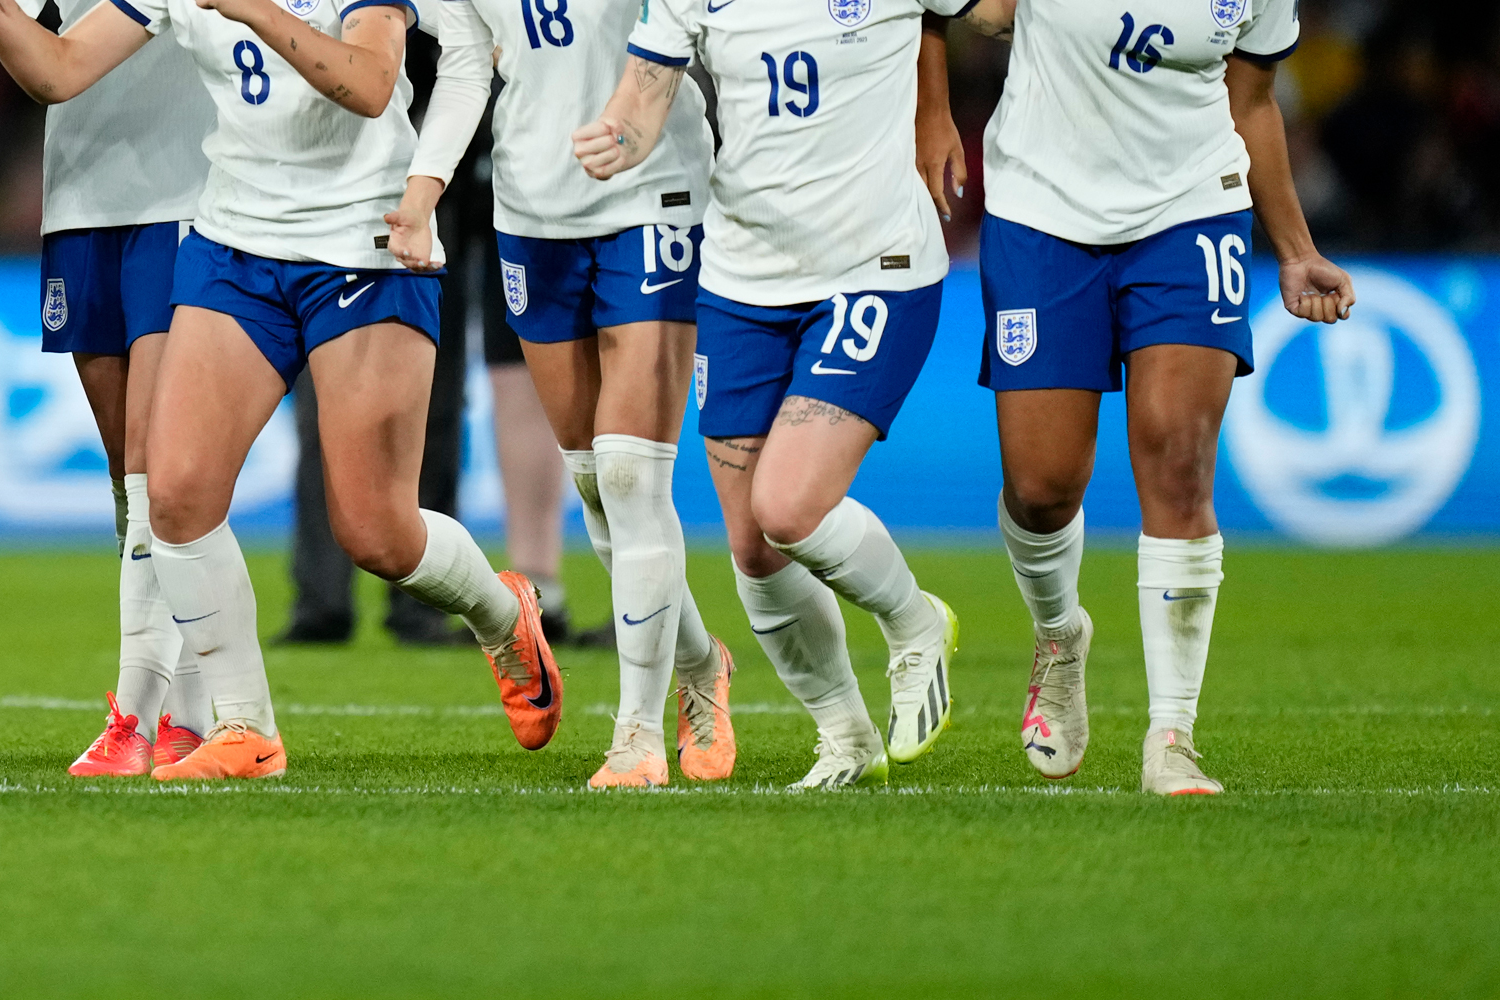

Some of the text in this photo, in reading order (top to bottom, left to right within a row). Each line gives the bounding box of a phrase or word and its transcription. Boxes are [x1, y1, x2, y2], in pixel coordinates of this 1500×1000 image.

[232, 40, 272, 106] 8
[1108, 11, 1175, 73] 16
[760, 50, 821, 118] 19
[642, 224, 694, 274] 18
[1195, 233, 1247, 306] 16
[820, 292, 890, 363] 19
